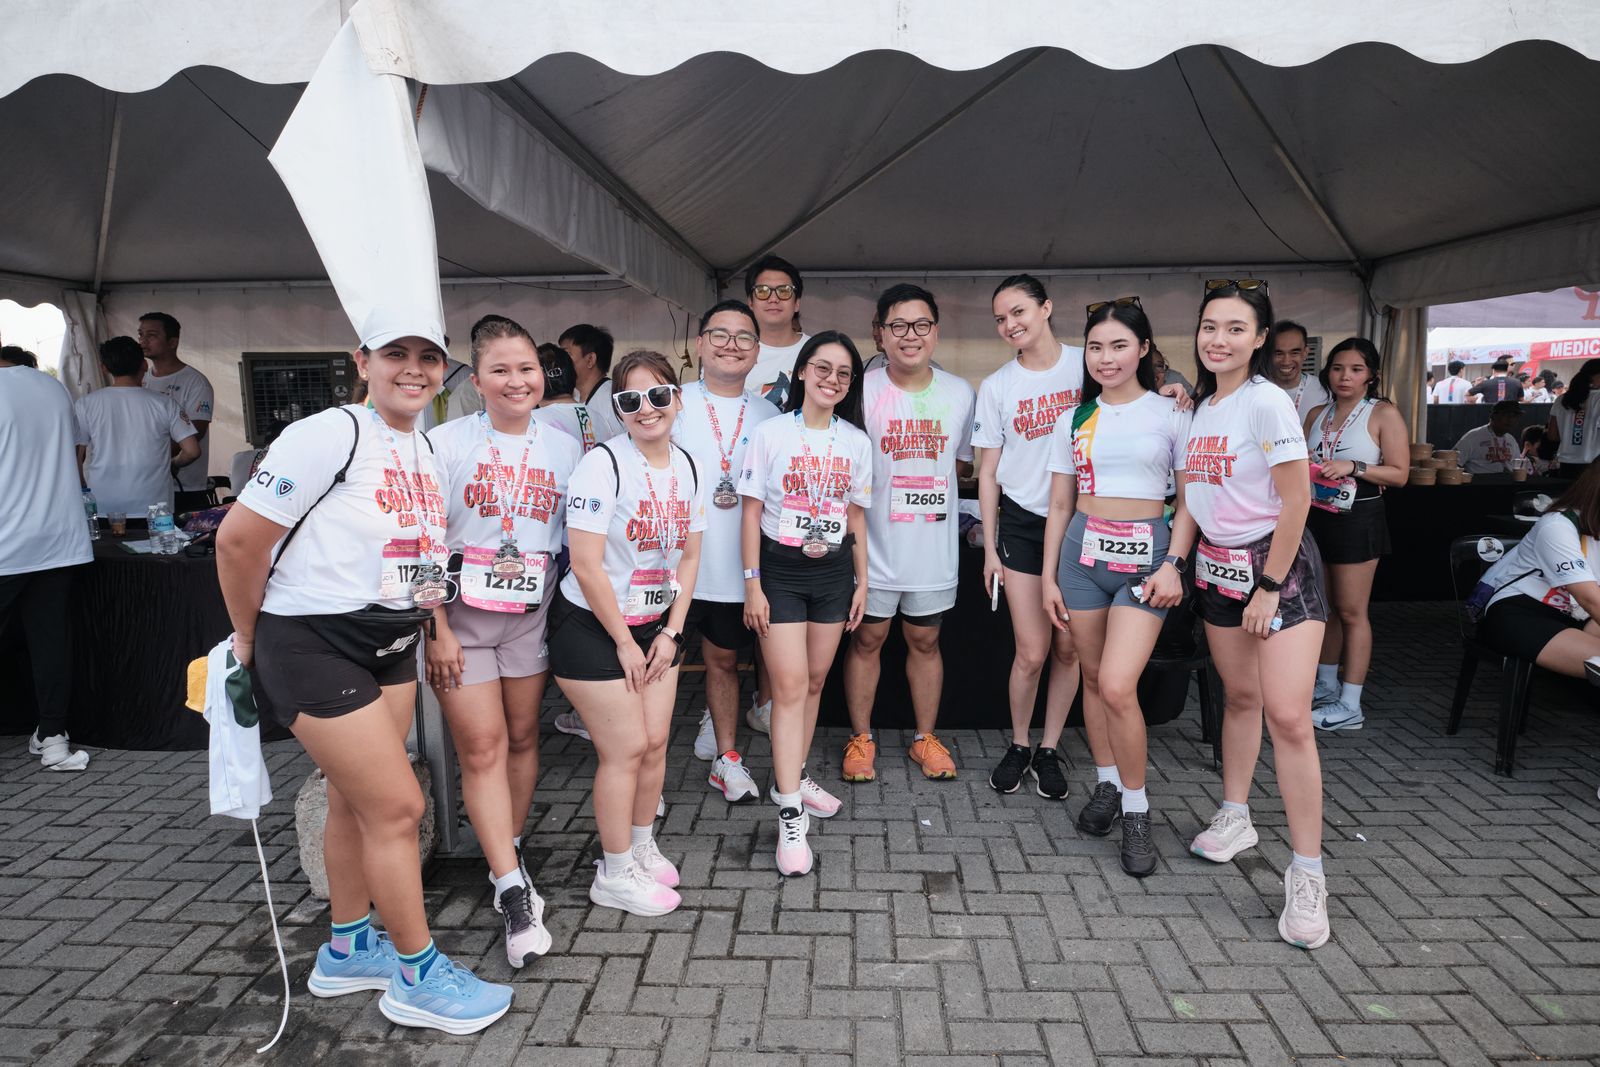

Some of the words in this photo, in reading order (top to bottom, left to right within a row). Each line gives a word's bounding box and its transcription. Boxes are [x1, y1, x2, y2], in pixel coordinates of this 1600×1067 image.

[1550, 339, 1600, 357] MEDIC
[1037, 388, 1082, 410] MANILA
[905, 419, 942, 434] MANILA
[880, 434, 949, 454] COLORFEST
[502, 465, 556, 489] MNILA
[464, 483, 562, 514] COLFEST
[568, 496, 586, 509] JCI
[905, 493, 945, 505] 12605
[831, 507, 844, 515] 10K
[796, 516, 841, 533] 1239
[1134, 526, 1149, 534] 10K
[1099, 539, 1149, 555] 12232
[526, 559, 542, 567] 10K
[1557, 561, 1575, 572] JCI
[1206, 561, 1249, 582] 12225
[485, 572, 538, 592] 12125
